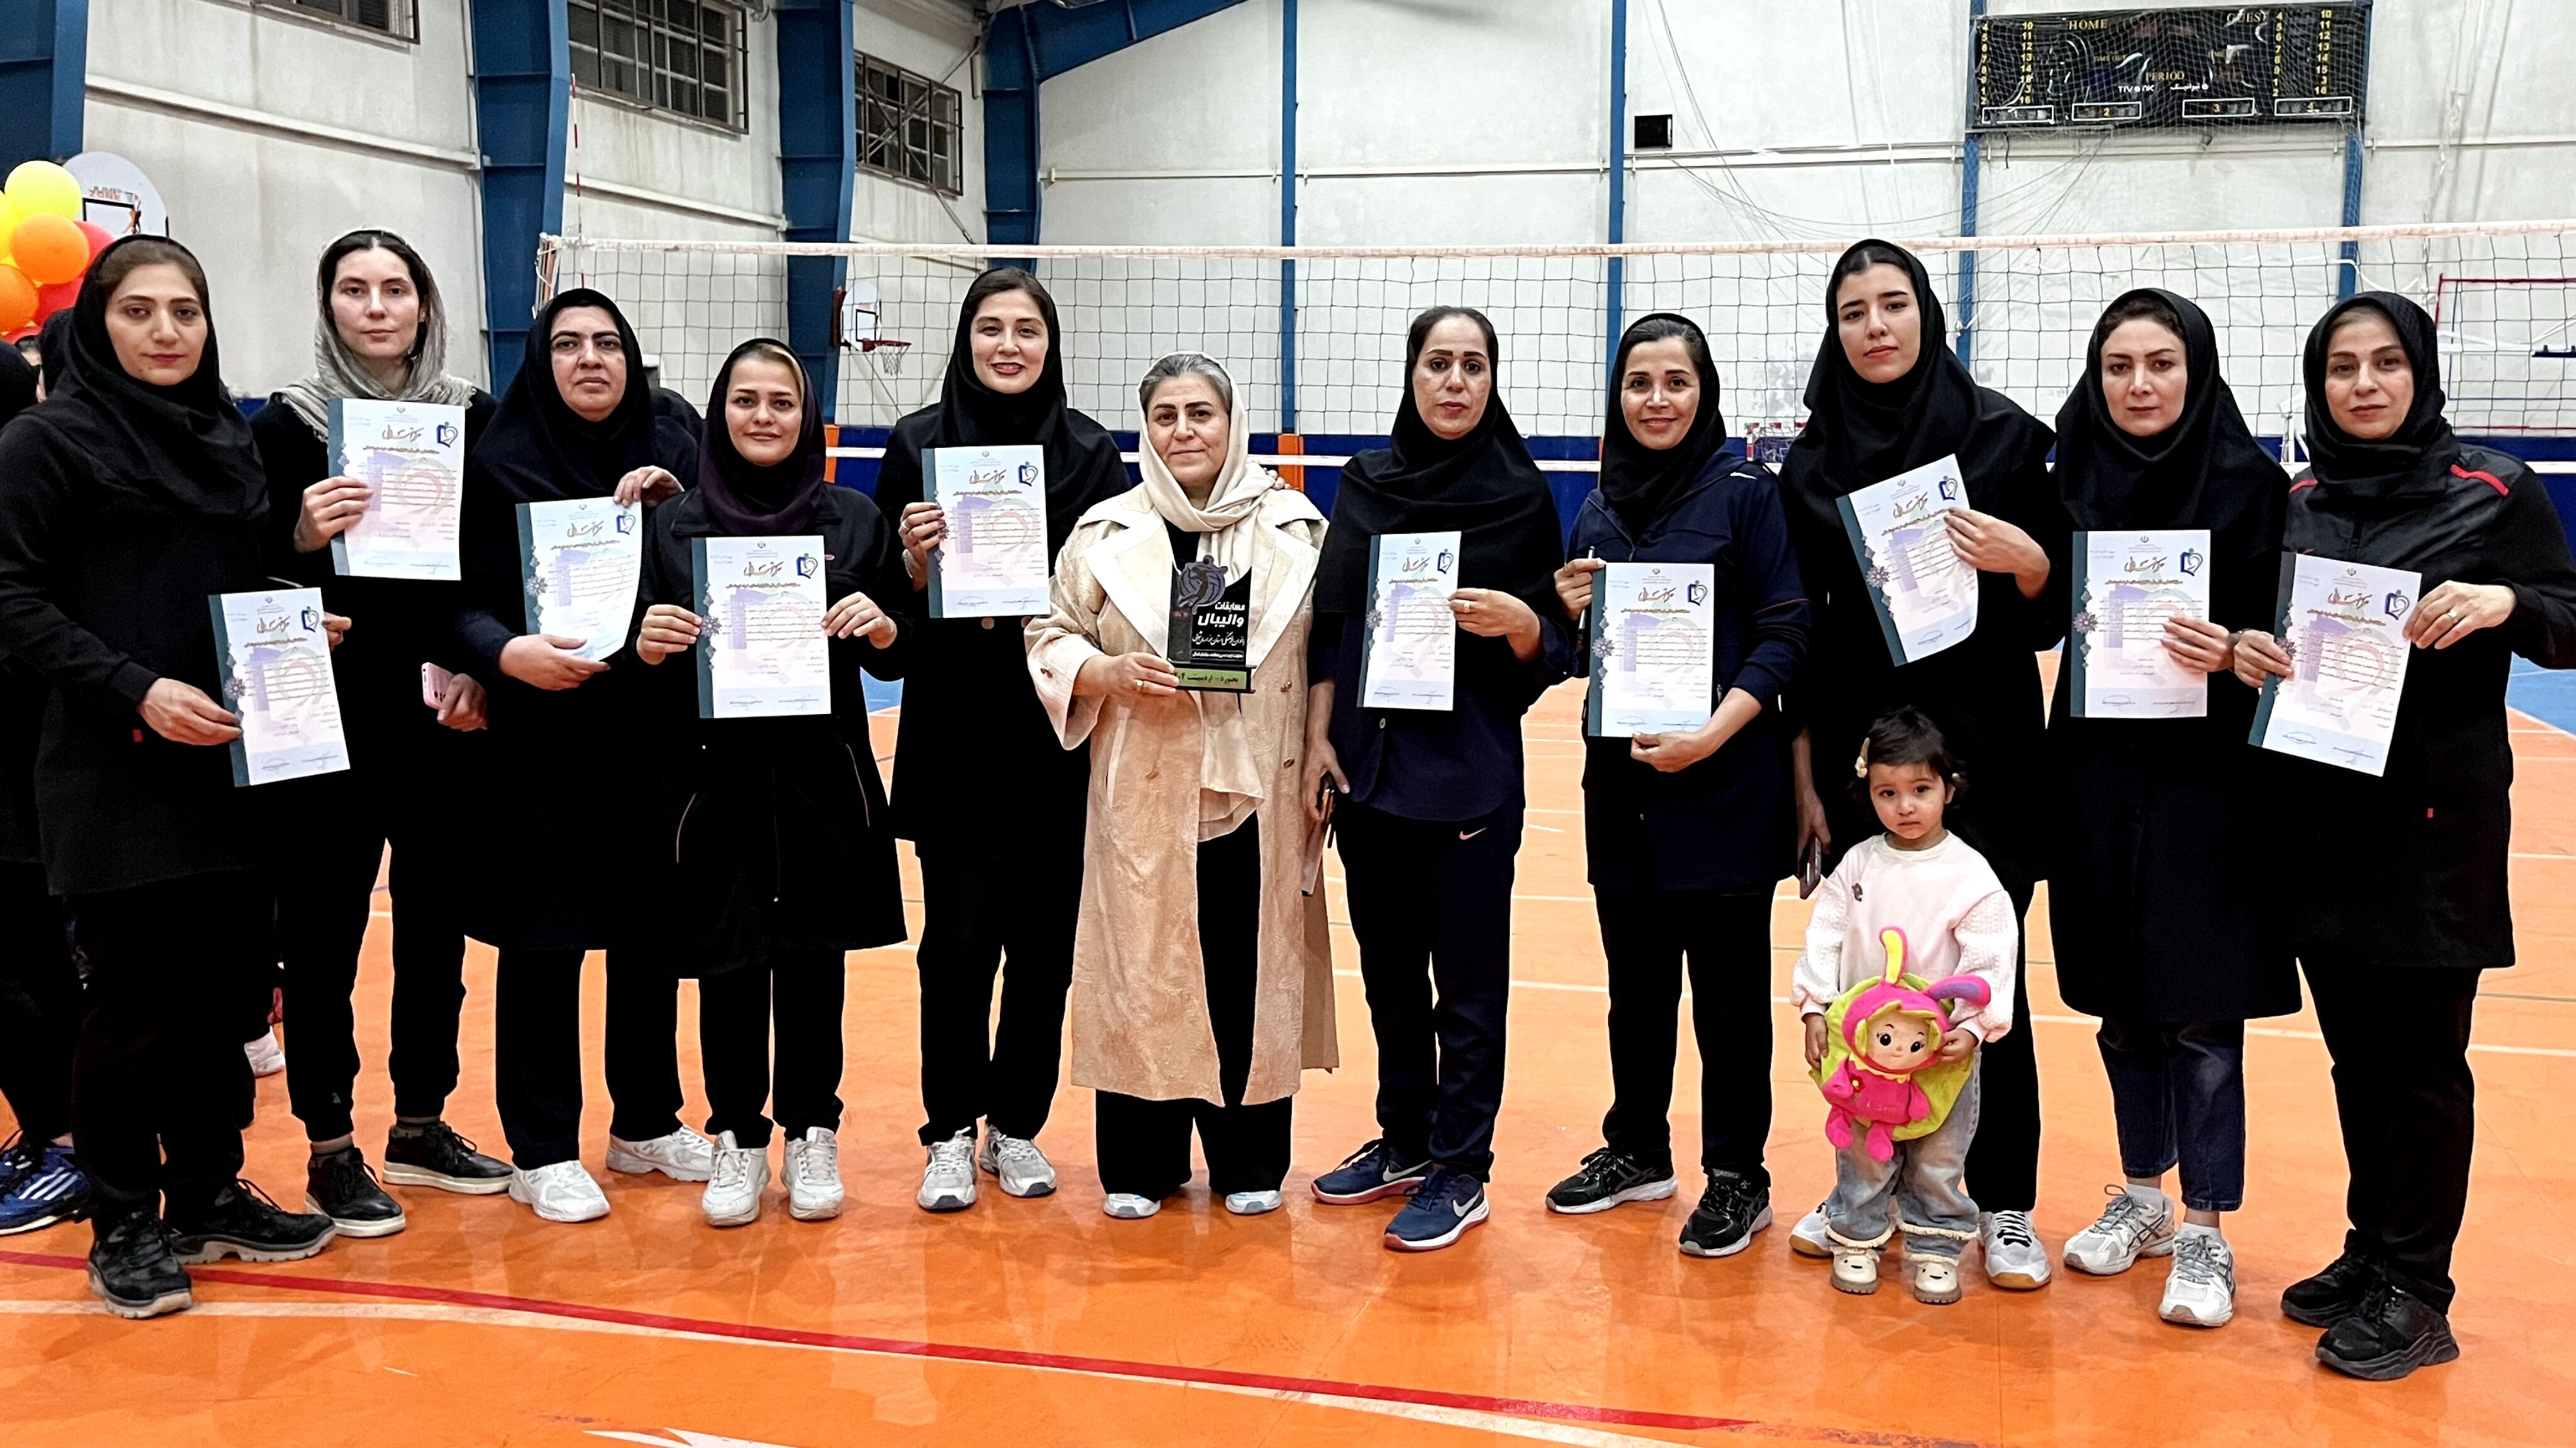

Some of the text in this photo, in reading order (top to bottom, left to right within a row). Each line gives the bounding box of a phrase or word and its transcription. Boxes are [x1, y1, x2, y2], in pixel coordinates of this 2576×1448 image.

[2275, 11, 2283, 20] 4
[2321, 10, 2332, 18] 10
[2022, 21, 2033, 30] 10
[2068, 19, 2108, 30] HOME
[2276, 23, 2282, 31] 5
[2319, 21, 2331, 29] 11
[2022, 31, 2032, 40] 11
[2319, 31, 2331, 40] 12
[2022, 42, 2033, 50] 12
[2275, 45, 2281, 53] 7
[2318, 43, 2329, 51] 13
[2317, 53, 2328, 62] 14
[2020, 64, 2032, 72] 14
[2316, 65, 2328, 74] 15
[2145, 70, 2185, 81] PERIOD
[2314, 86, 2327, 94] 16
[2103, 107, 2111, 116] 2
[1214, 601, 1245, 613] مسابقات
[1197, 613, 1245, 628] والیبال
